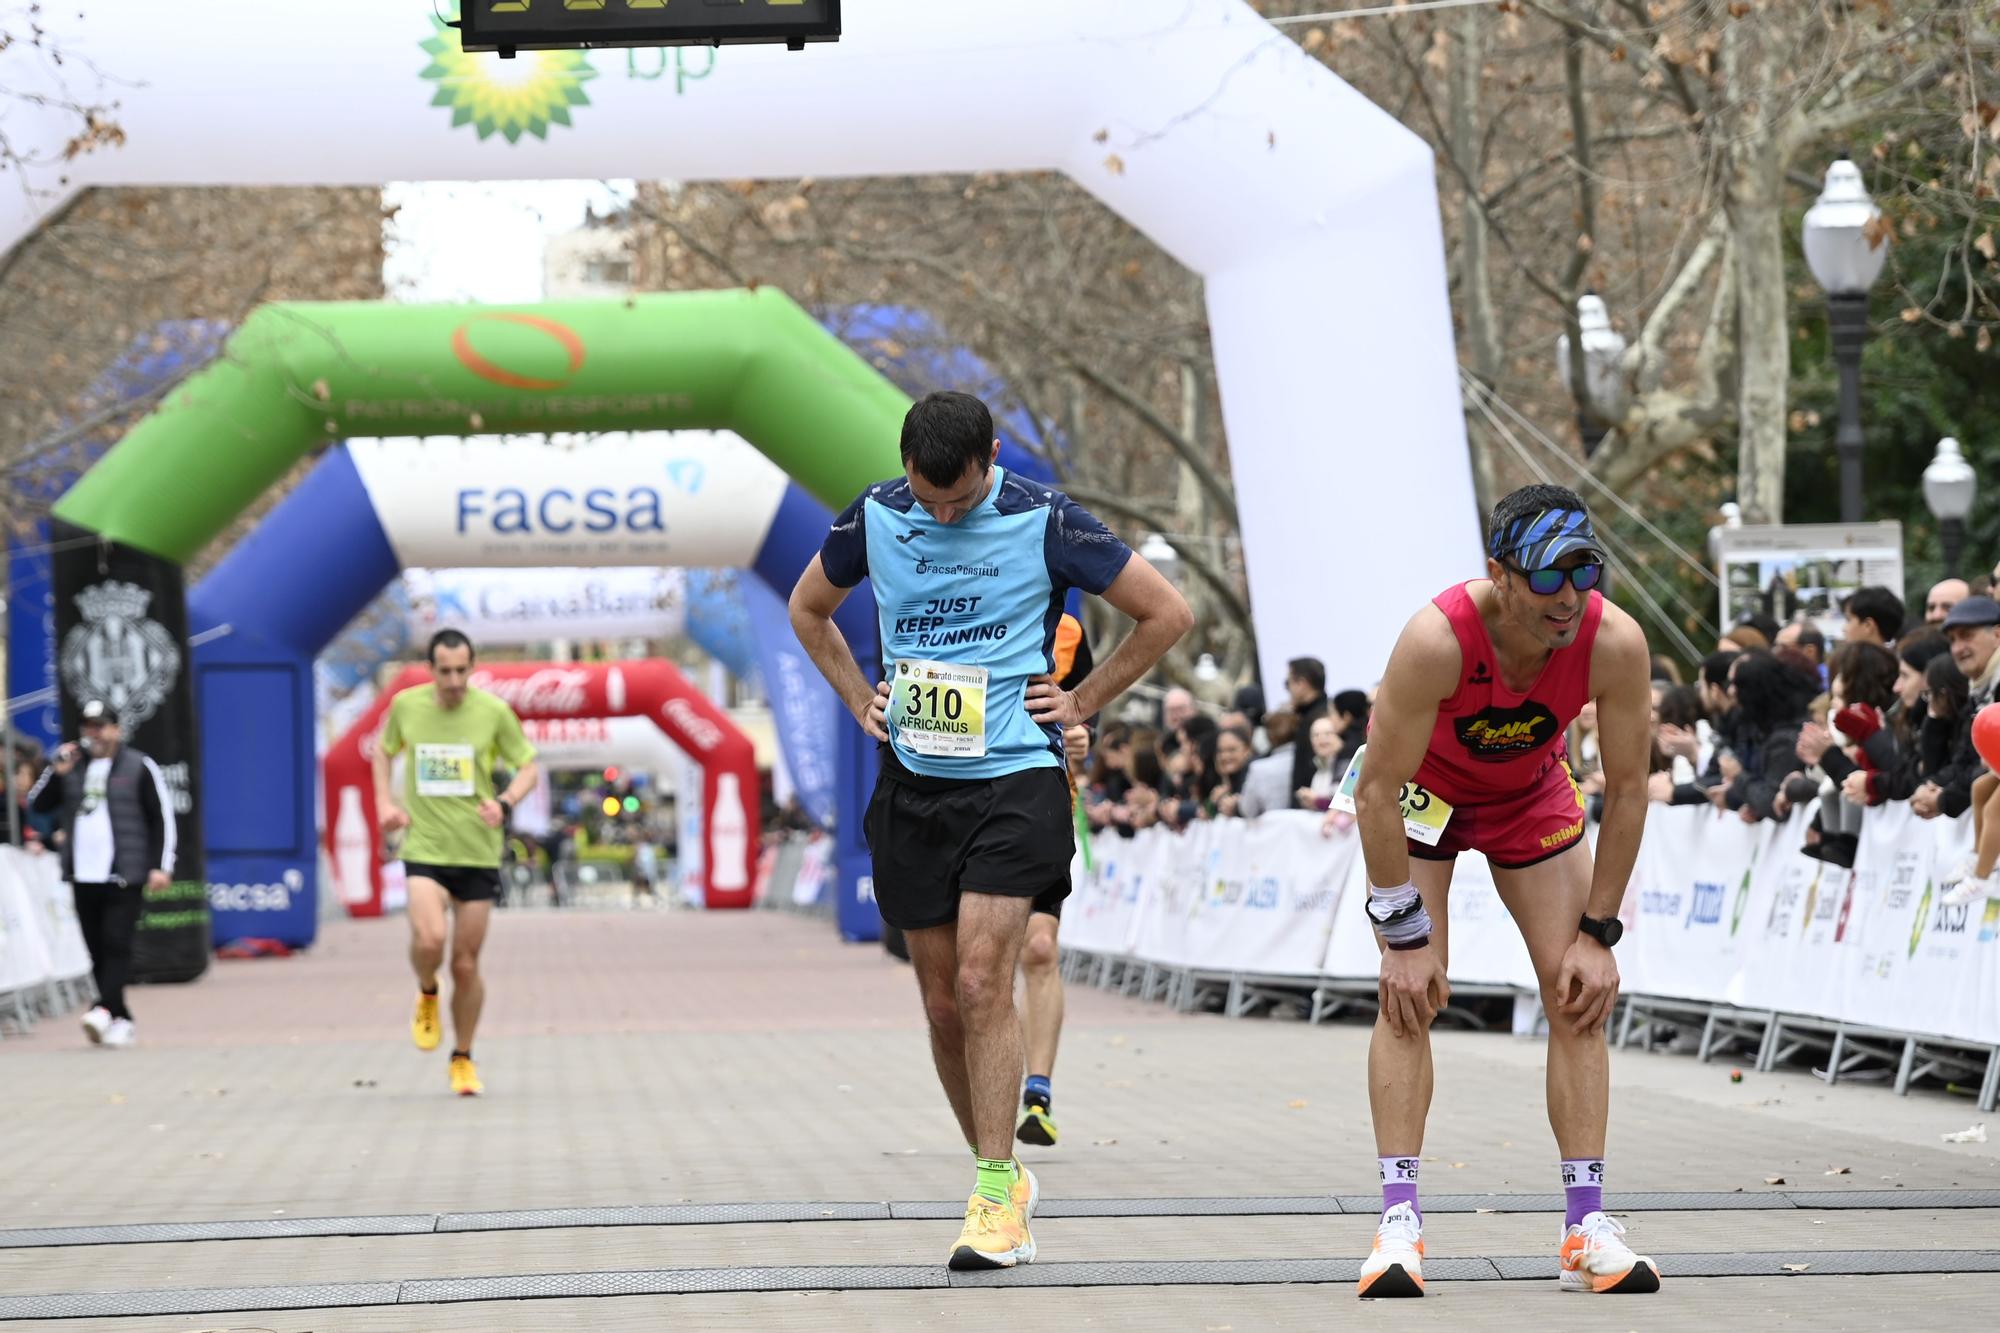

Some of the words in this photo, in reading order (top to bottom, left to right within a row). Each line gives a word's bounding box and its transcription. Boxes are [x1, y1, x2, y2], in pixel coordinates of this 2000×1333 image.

[925, 596, 982, 615] JUST
[895, 616, 944, 634] KEEP
[916, 624, 1008, 648] RUNNING
[906, 683, 962, 720] 310
[899, 715, 968, 734] AFRICANUS
[1540, 816, 1583, 848] BRINK
